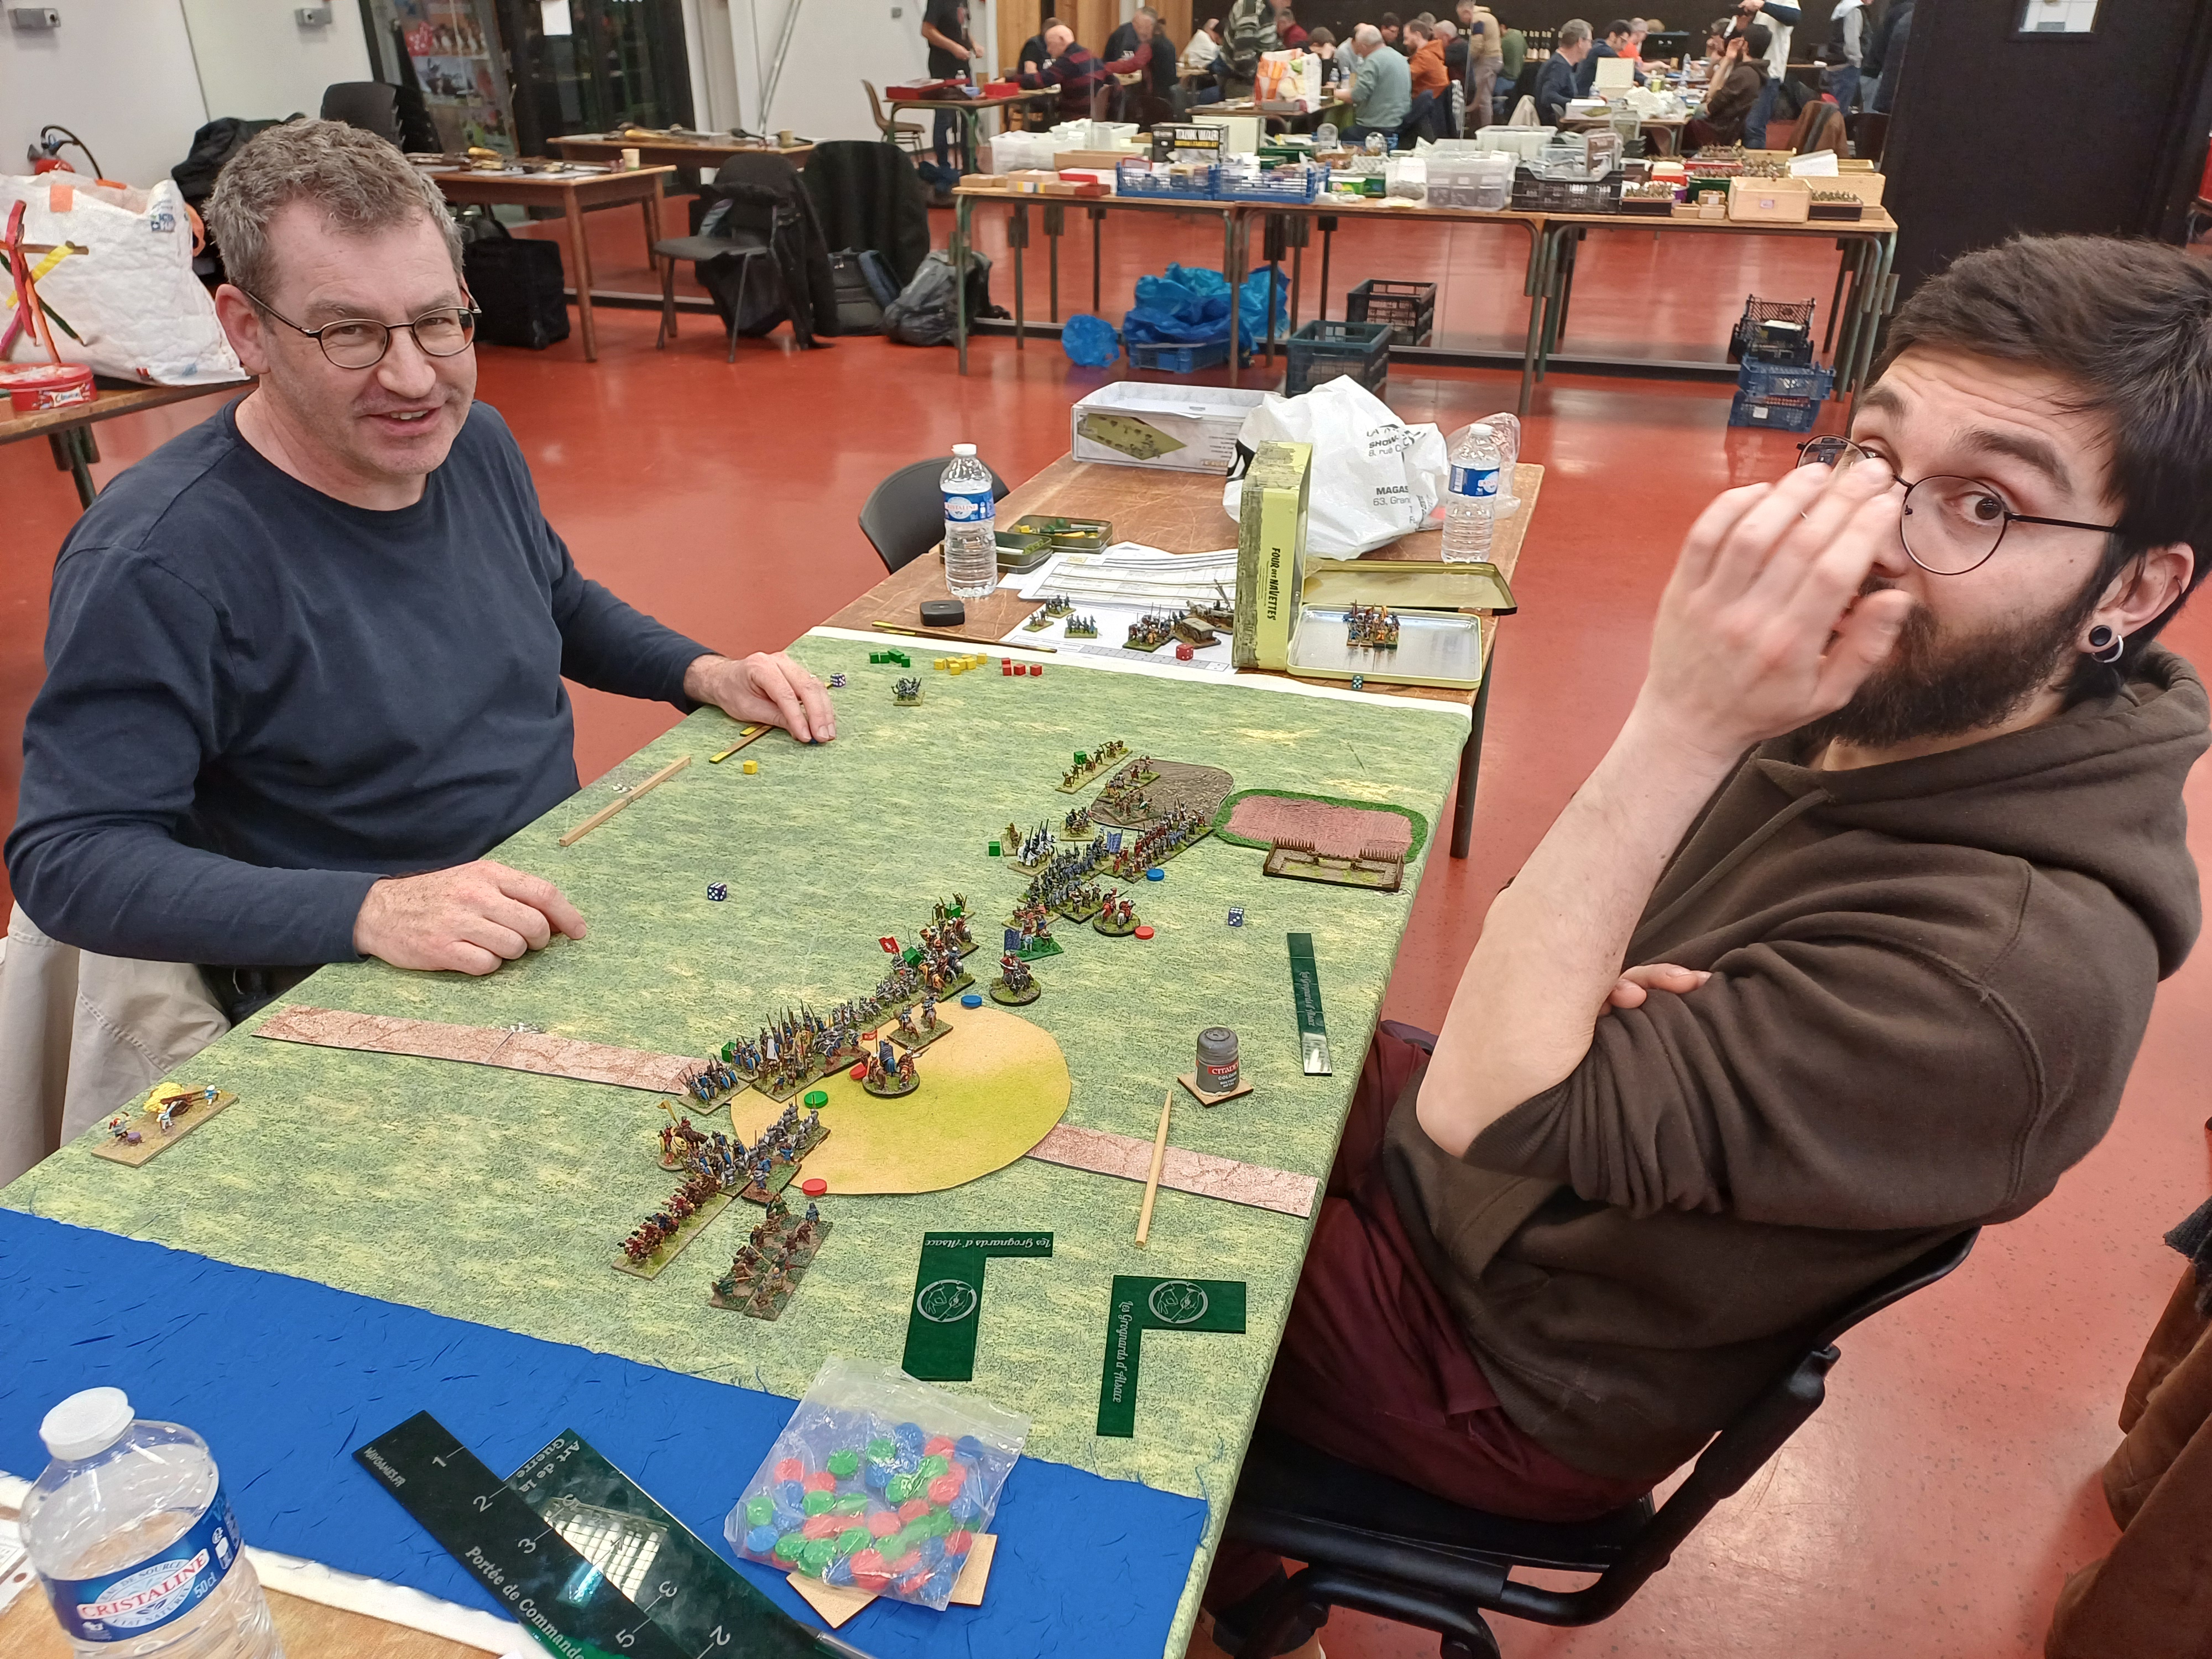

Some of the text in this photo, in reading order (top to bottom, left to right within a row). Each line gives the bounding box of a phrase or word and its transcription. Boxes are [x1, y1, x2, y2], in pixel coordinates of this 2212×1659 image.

[1373, 497, 1388, 506] 63,
[1270, 547, 1281, 568] FOUR
[975, 1238, 1033, 1248] Grognards
[1036, 1238, 1051, 1248] Les
[1118, 1301, 1134, 1313] Les
[1116, 1314, 1133, 1360] Grognards
[432, 1456, 447, 1468] 1
[516, 1438, 565, 1478] Guerre
[518, 1440, 580, 1492] Art de la
[473, 1495, 493, 1512] 2
[518, 1538, 536, 1553] 3
[120, 1576, 134, 1587] DE
[139, 1561, 184, 1577] SOURCE
[465, 1546, 505, 1585] Portée
[502, 1584, 520, 1600] de
[82, 1553, 206, 1617] CRISTALINE
[194, 1571, 217, 1599] 50cl
[659, 1581, 678, 1598] 3
[615, 1629, 635, 1648] 5
[709, 1625, 731, 1646] 2
